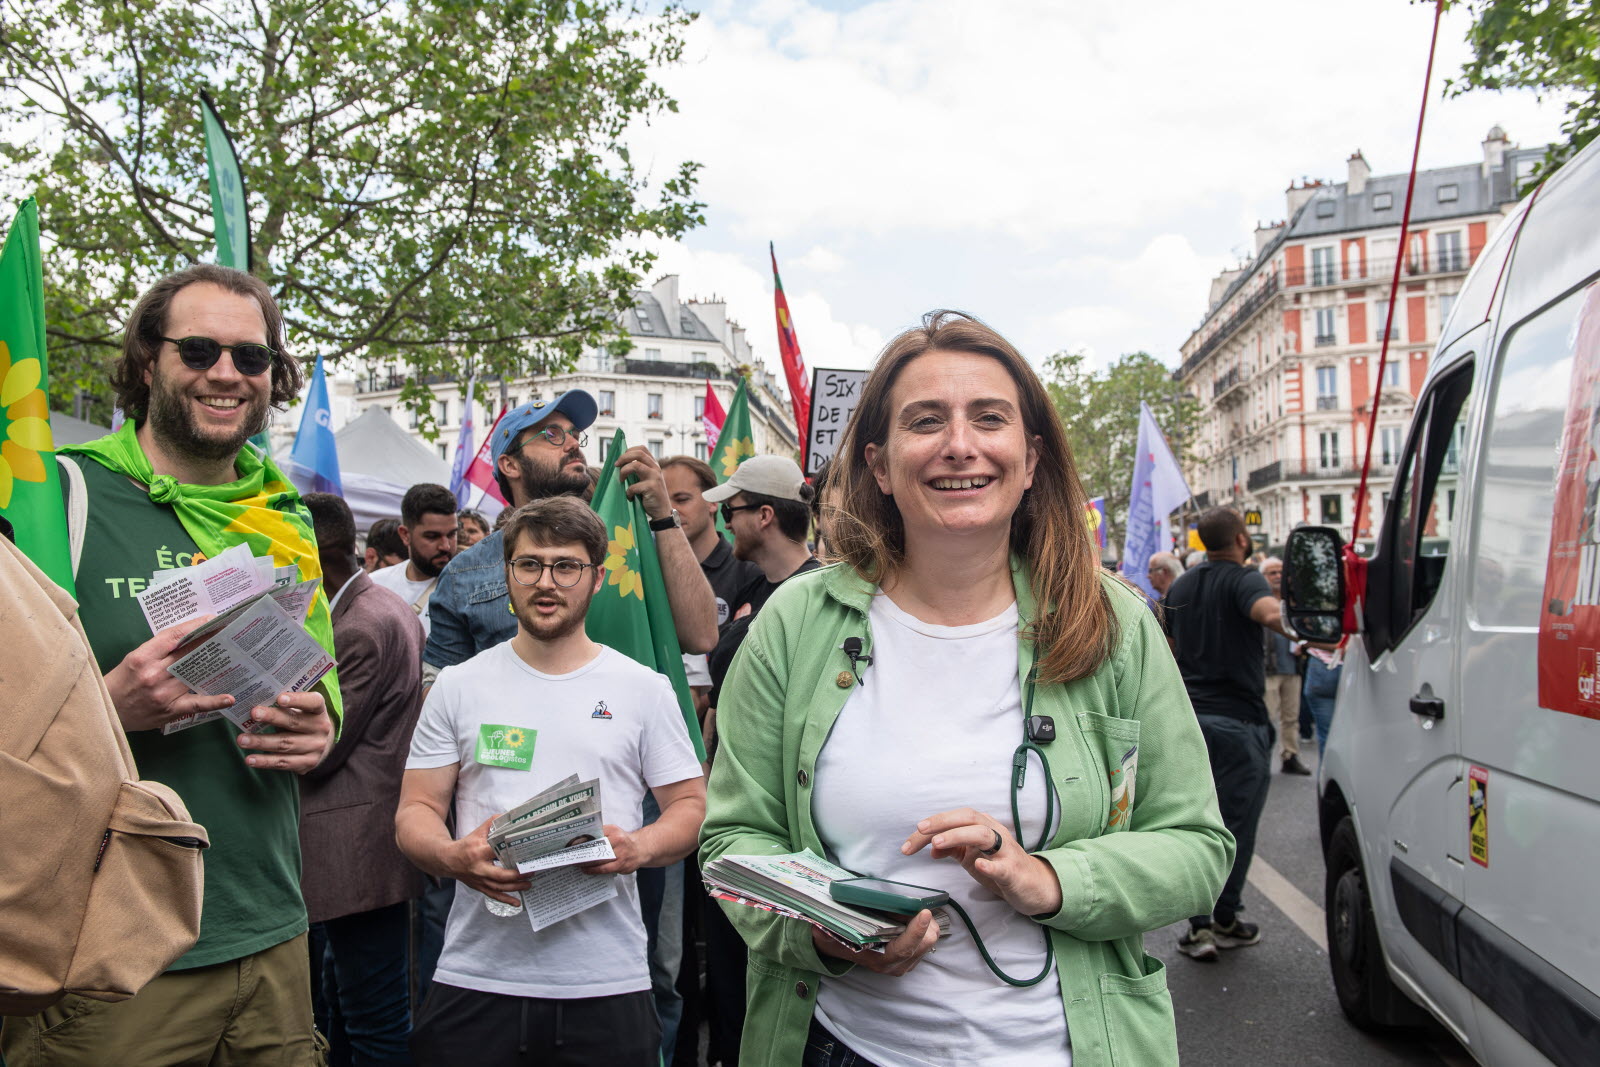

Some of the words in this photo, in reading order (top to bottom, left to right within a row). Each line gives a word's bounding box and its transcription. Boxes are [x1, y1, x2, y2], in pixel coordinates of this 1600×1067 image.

[825, 374, 856, 398] SIX
[818, 405, 841, 423] DE
[815, 429, 838, 445] ET
[149, 584, 171, 598] gauche
[177, 580, 192, 590] dans
[148, 606, 162, 616] pour
[162, 600, 174, 609] nos
[151, 611, 164, 620] pour
[170, 599, 189, 611] justice
[153, 612, 173, 625] sociale
[185, 601, 198, 610] paix
[155, 620, 170, 630] juste
[176, 607, 197, 620] durable
[306, 654, 328, 677] 2027
[557, 797, 567, 806] DE
[568, 790, 588, 802] VOUS
[529, 828, 556, 840] BESOIN
[569, 818, 589, 827] VOUS
